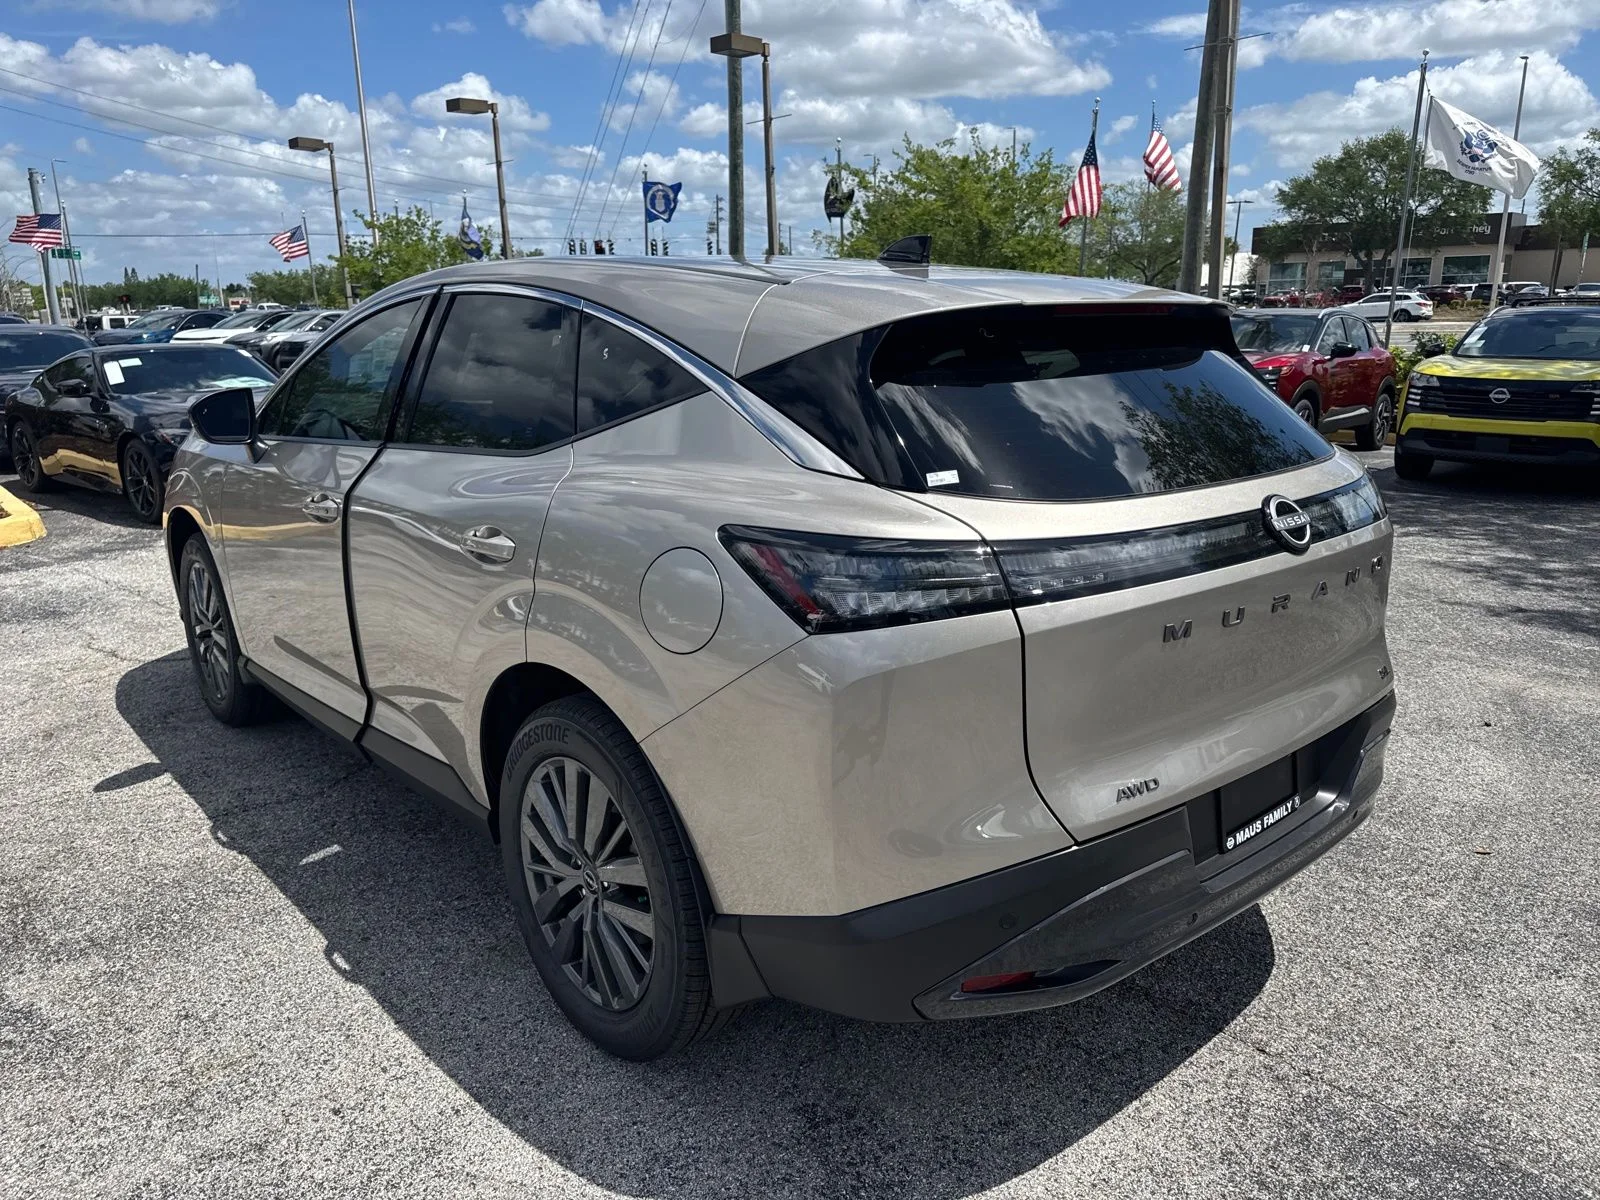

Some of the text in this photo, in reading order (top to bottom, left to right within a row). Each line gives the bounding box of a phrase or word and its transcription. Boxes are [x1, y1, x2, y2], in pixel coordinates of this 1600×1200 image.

[1273, 513, 1311, 529] NISSAN
[1163, 553, 1384, 643] MURANO
[505, 723, 571, 784] BRIDGESTONE
[1116, 777, 1160, 803] AWD
[1235, 800, 1293, 845] MAUS FAMILY
